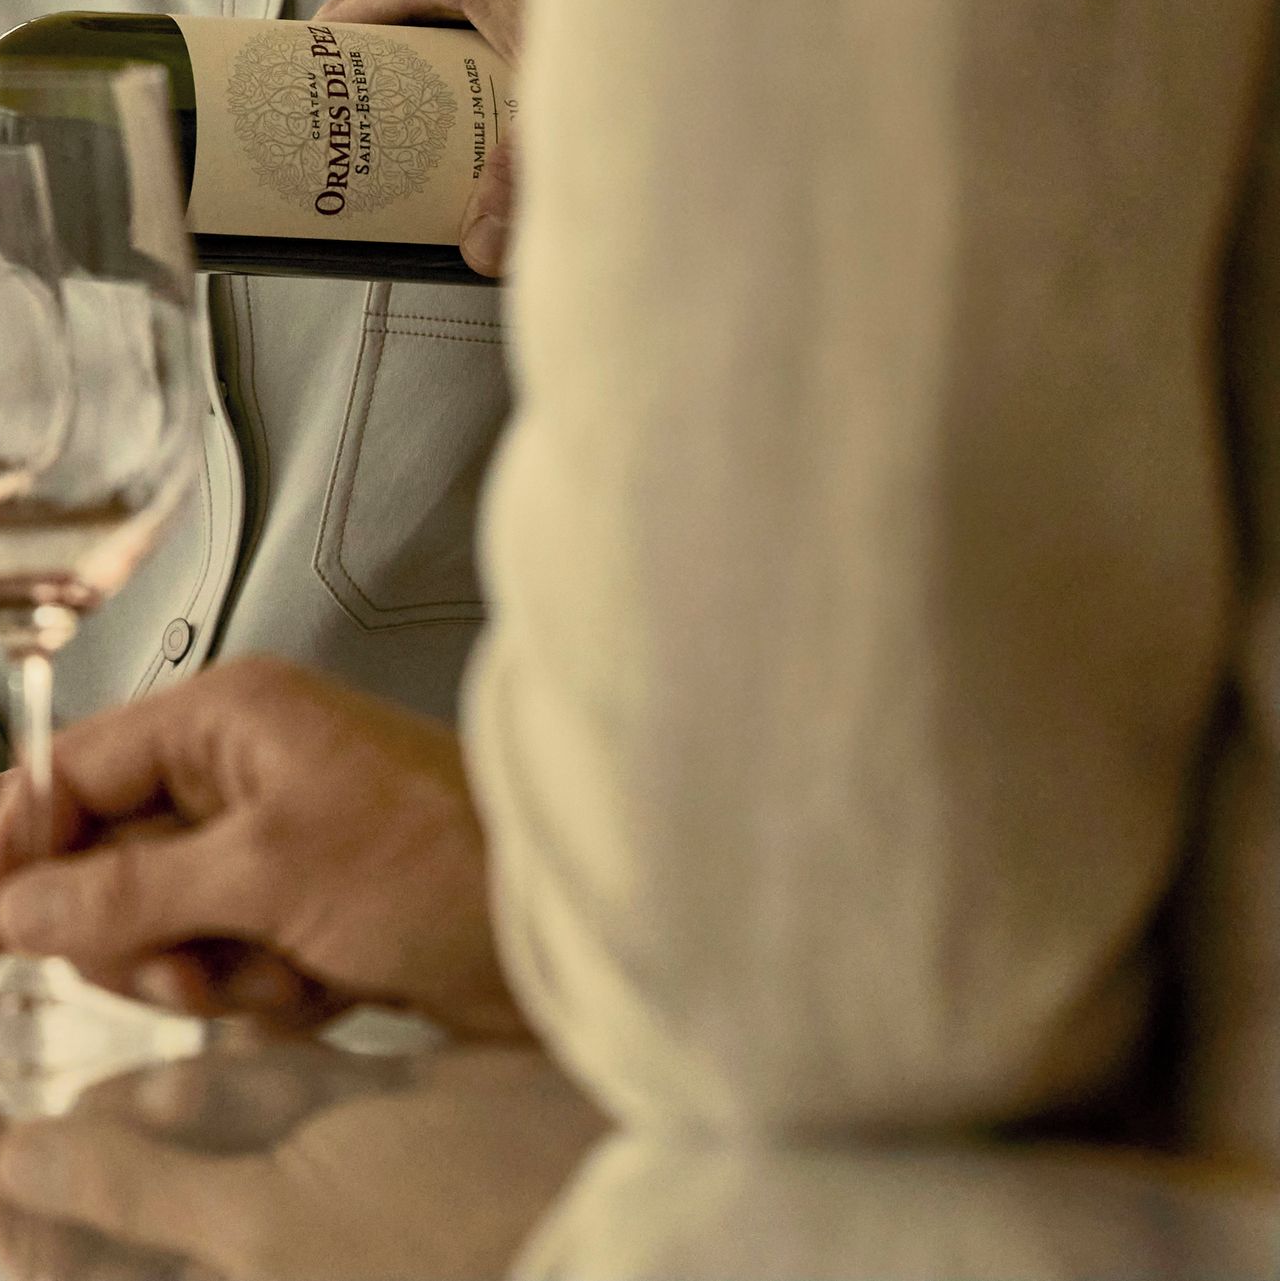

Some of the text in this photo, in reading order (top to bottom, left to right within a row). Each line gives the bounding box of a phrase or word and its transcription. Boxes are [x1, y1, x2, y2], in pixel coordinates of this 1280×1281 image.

[307, 72, 320, 141] CHÂTEAU
[307, 26, 351, 216] ORMES DE PEZ
[350, 51, 371, 175] SAINT-ESTÈPHE
[464, 57, 482, 94] CAZES
